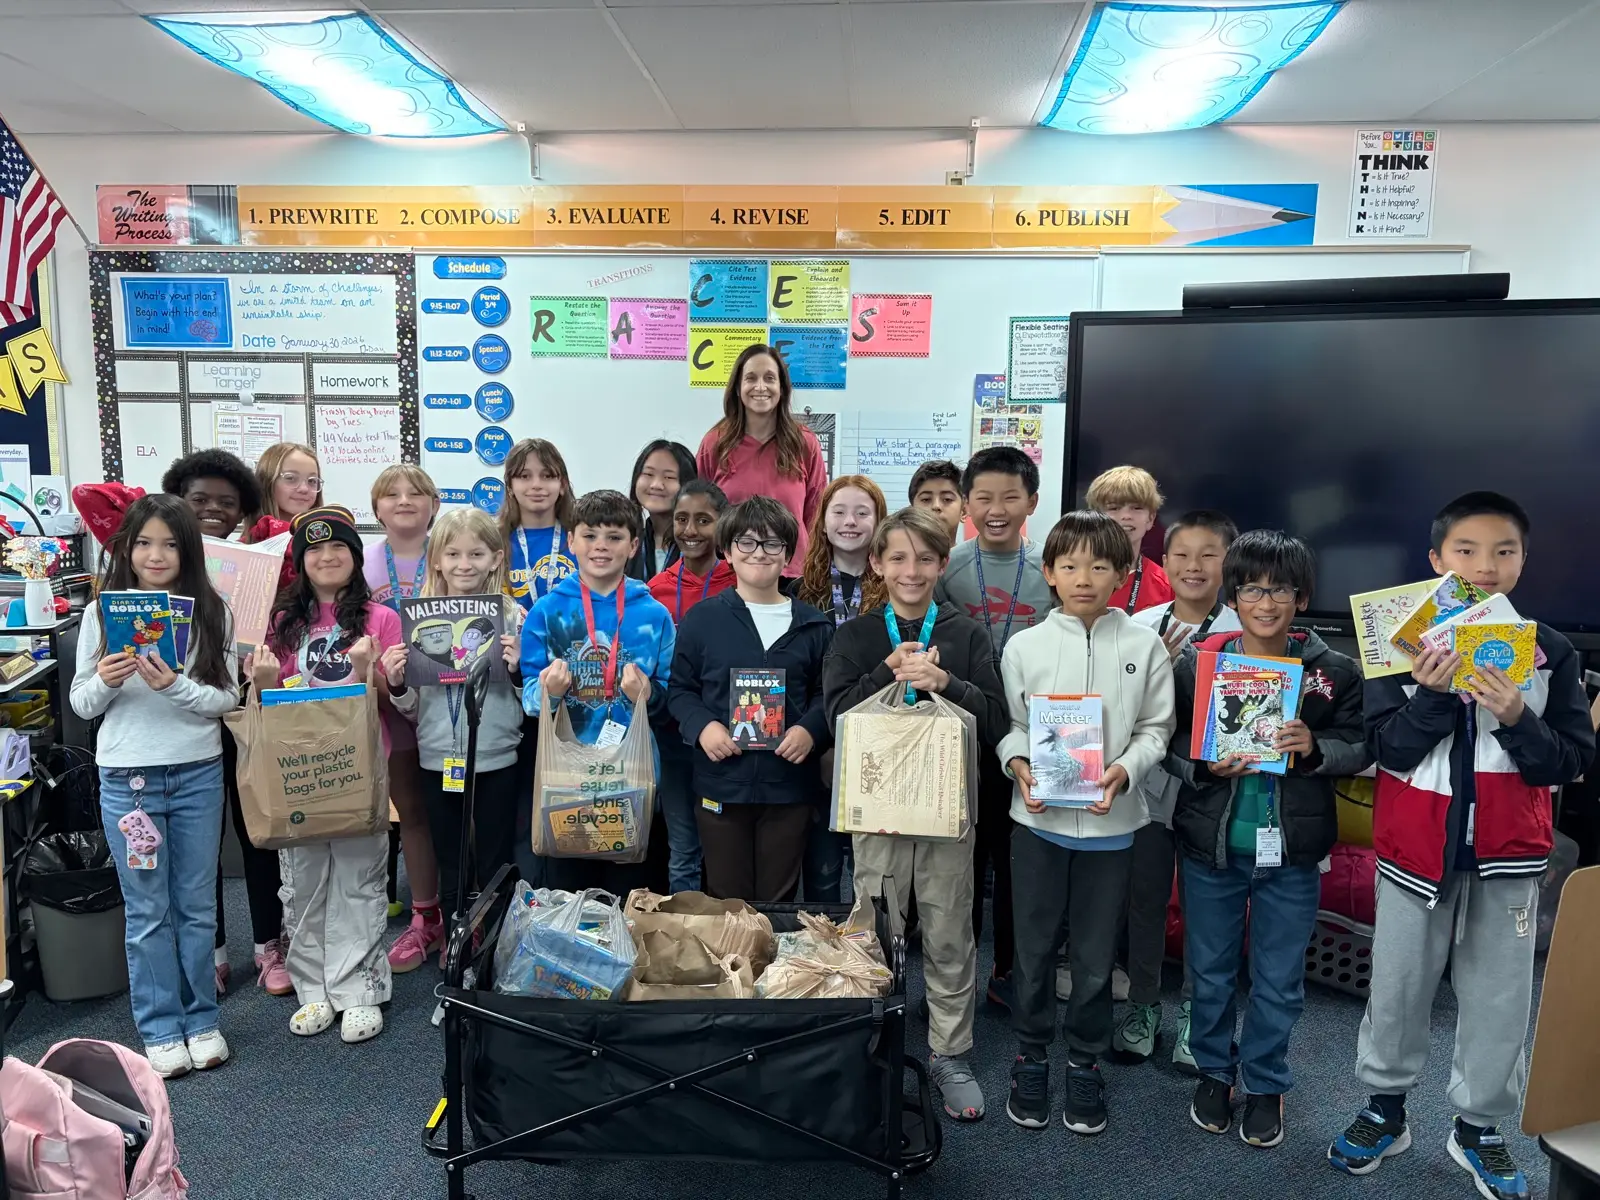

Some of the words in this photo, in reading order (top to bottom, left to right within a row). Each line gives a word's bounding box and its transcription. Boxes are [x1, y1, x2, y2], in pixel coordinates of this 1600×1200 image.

[1359, 155, 1429, 170] THINK
[1362, 173, 1369, 182] T
[1391, 172, 1409, 180] True?
[1360, 185, 1369, 193] H
[1376, 185, 1380, 193] Is
[1389, 185, 1415, 196] Helpful?
[126, 190, 157, 208] The
[1361, 198, 1365, 206] I
[1388, 199, 1419, 209] Inspiring?
[112, 207, 176, 227] Writing
[249, 210, 263, 225] 1.
[269, 209, 378, 225] PREWRITE
[400, 210, 415, 225] 2.
[420, 209, 520, 225] COMPOSE
[547, 209, 561, 225] 3.
[569, 208, 670, 225] EVALUATE
[710, 209, 726, 225] 4.
[732, 208, 809, 225] REVISE
[879, 209, 894, 226] 5.
[901, 209, 950, 226] EDIT
[1016, 210, 1030, 226] 6.
[1038, 210, 1130, 226] PUBLISH
[1357, 212, 1366, 220] N
[1374, 212, 1378, 220] Is
[1387, 212, 1424, 222] Necessary?
[114, 222, 174, 240] Process
[1356, 225, 1364, 233] K
[1372, 225, 1377, 233] Is
[1386, 225, 1405, 233] Kind?
[448, 262, 491, 274] Schedule
[586, 263, 654, 289] TRANSITIONS
[134, 290, 166, 300] What's
[169, 294, 191, 303] your
[194, 291, 216, 303] plan?
[270, 284, 278, 293] a
[282, 283, 315, 294] storm
[319, 282, 329, 297] of
[690, 273, 714, 308] C
[772, 275, 798, 309] E
[340, 299, 355, 307] on
[480, 294, 500, 302] Period
[136, 307, 158, 320] Begin
[162, 307, 180, 316] with
[184, 308, 199, 316] the
[203, 307, 216, 317] end
[137, 324, 144, 333] in
[148, 323, 170, 333] mind!
[532, 309, 556, 344] R
[611, 311, 635, 345] A
[852, 307, 878, 342] S
[242, 334, 276, 347] Date
[281, 335, 328, 352] January
[479, 345, 503, 354] Specials
[22, 342, 48, 374] S
[692, 338, 714, 371] C
[202, 364, 261, 379] Learning
[212, 376, 256, 389] Target
[320, 375, 389, 388] Homework
[320, 407, 346, 416] Finish
[325, 418, 339, 429] by
[366, 433, 379, 441] test
[484, 433, 504, 441] Period
[876, 438, 888, 448] We
[892, 439, 912, 448] start
[925, 443, 961, 451] paragraph
[136, 445, 158, 457] ELA
[858, 448, 867, 458] by
[908, 449, 925, 460] Every
[858, 458, 889, 466] sentence
[481, 483, 500, 491] Period
[1129, 580, 1140, 607] Southwest
[405, 600, 498, 621] VALENSTEINS
[1360, 601, 1376, 639] bucket
[308, 652, 351, 663] NASA
[1364, 648, 1385, 666] fill
[1039, 711, 1092, 725] Matter
[277, 752, 308, 769] We'll
[311, 744, 356, 763] recycle
[281, 768, 310, 784] your
[313, 757, 354, 777] plastic
[284, 780, 316, 796] bags
[318, 776, 337, 789] for
[339, 772, 364, 788] you.
